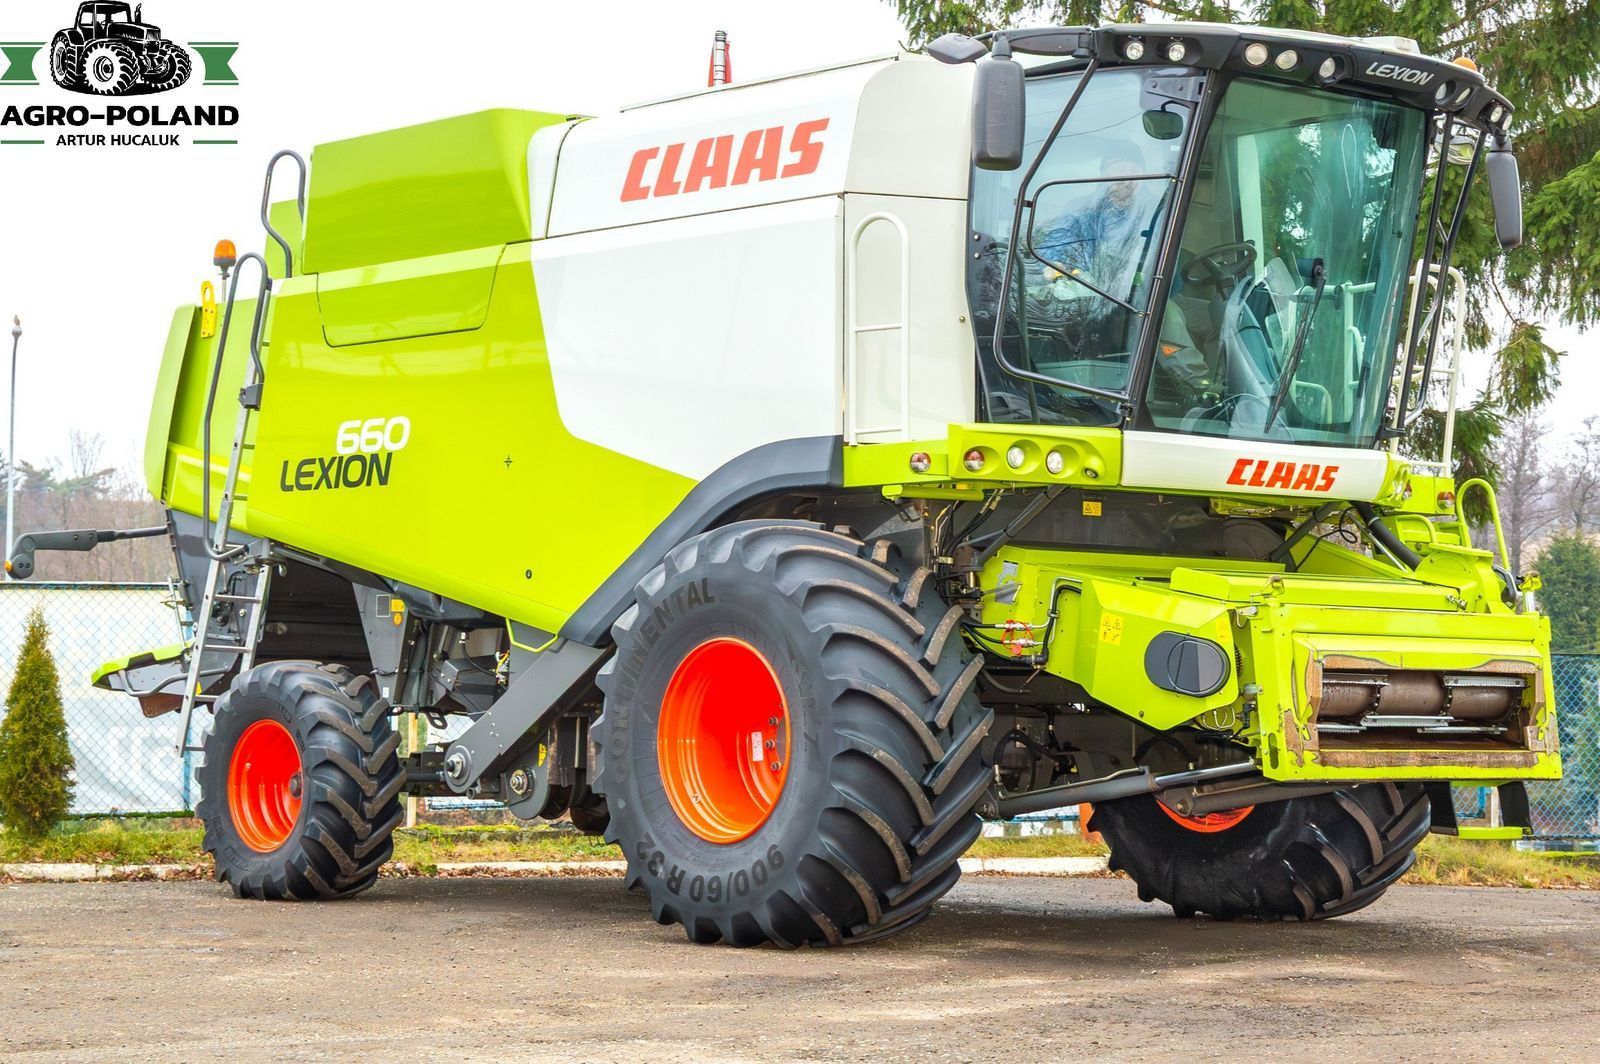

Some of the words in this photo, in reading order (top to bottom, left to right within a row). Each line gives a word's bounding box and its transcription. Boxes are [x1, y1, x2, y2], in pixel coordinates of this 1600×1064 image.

[1365, 62, 1435, 86] LEXION
[620, 118, 830, 202] CLAAS
[336, 415, 411, 455] 660
[280, 452, 393, 492] LEXION
[1226, 457, 1340, 493] CLAAS
